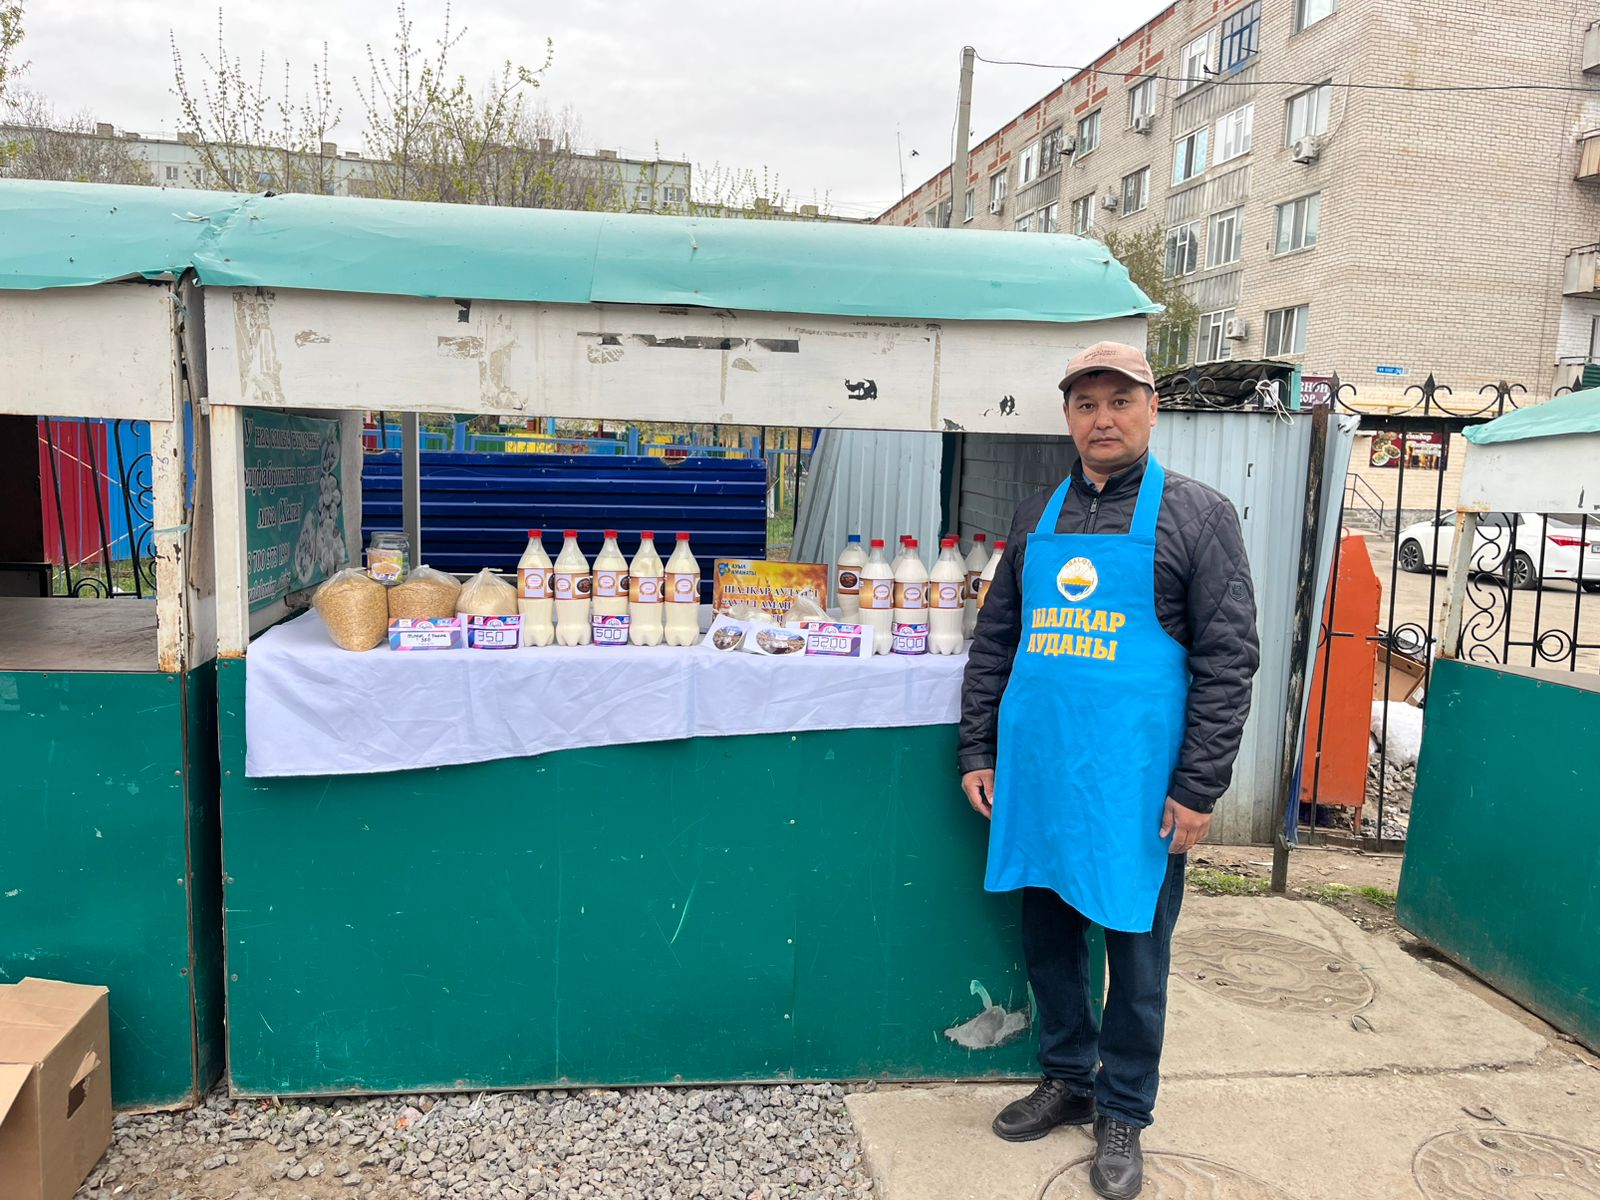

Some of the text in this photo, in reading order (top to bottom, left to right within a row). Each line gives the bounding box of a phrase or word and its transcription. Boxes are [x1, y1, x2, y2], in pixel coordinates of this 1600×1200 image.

[244, 418, 253, 447] У
[255, 427, 269, 448] нас
[253, 549, 266, 573] 700
[1032, 607, 1126, 632] ШАЛҚАР
[477, 630, 504, 642] 350
[595, 628, 622, 640] 500
[811, 637, 847, 649] 3200
[893, 637, 924, 649] 1500
[1027, 633, 1118, 661] АУДАНЫ
